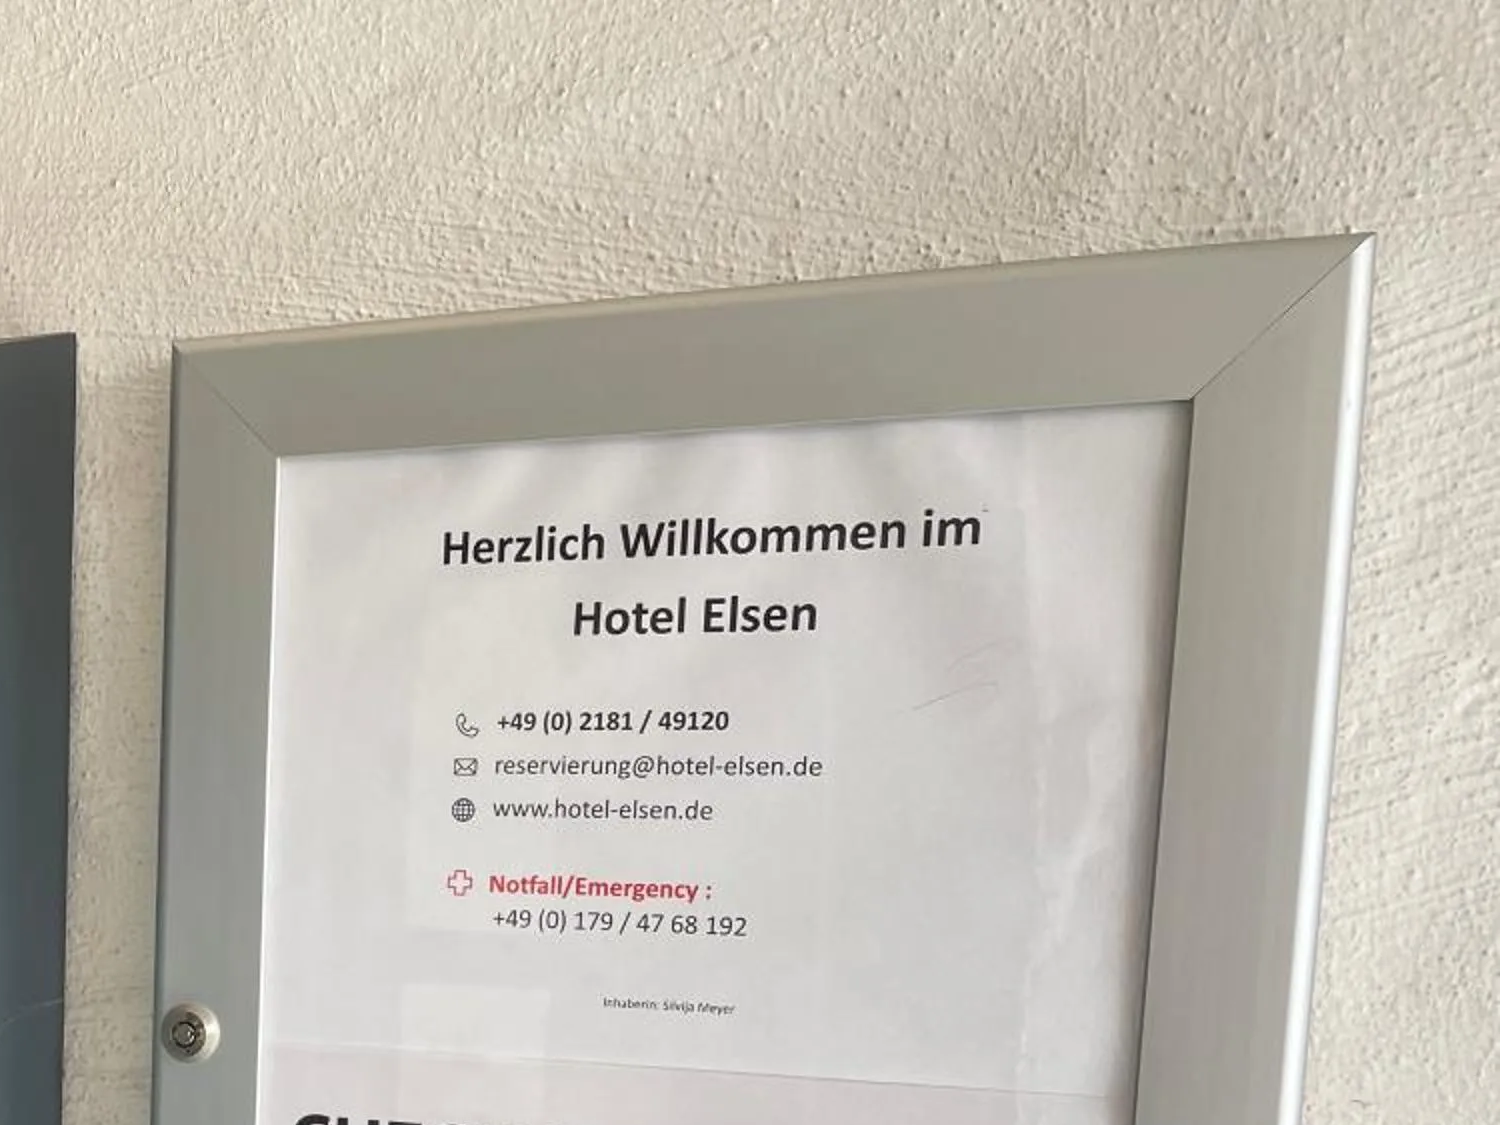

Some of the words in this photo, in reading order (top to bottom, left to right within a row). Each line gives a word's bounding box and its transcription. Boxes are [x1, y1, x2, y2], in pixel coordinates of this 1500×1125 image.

[442, 523, 605, 566] Herzlich
[620, 517, 906, 559] Willkommen
[922, 508, 981, 548] im
[573, 596, 686, 637] Hotel
[702, 595, 818, 634] Elsen
[497, 711, 537, 731] +49
[542, 710, 573, 735] (0)
[579, 711, 633, 731] 2181
[638, 710, 653, 734] /
[657, 711, 730, 732] 49120
[494, 755, 823, 779] reservierung@hotel-elsen.de
[493, 799, 714, 821] www.hotel-elsen.de
[489, 875, 699, 901] Notfall/Emergency
[493, 909, 531, 929] +49
[538, 909, 567, 933] (0)
[576, 912, 613, 931] 179
[619, 911, 631, 935] /
[636, 914, 664, 933] 47
[670, 915, 698, 934] 68
[706, 916, 747, 937] 192
